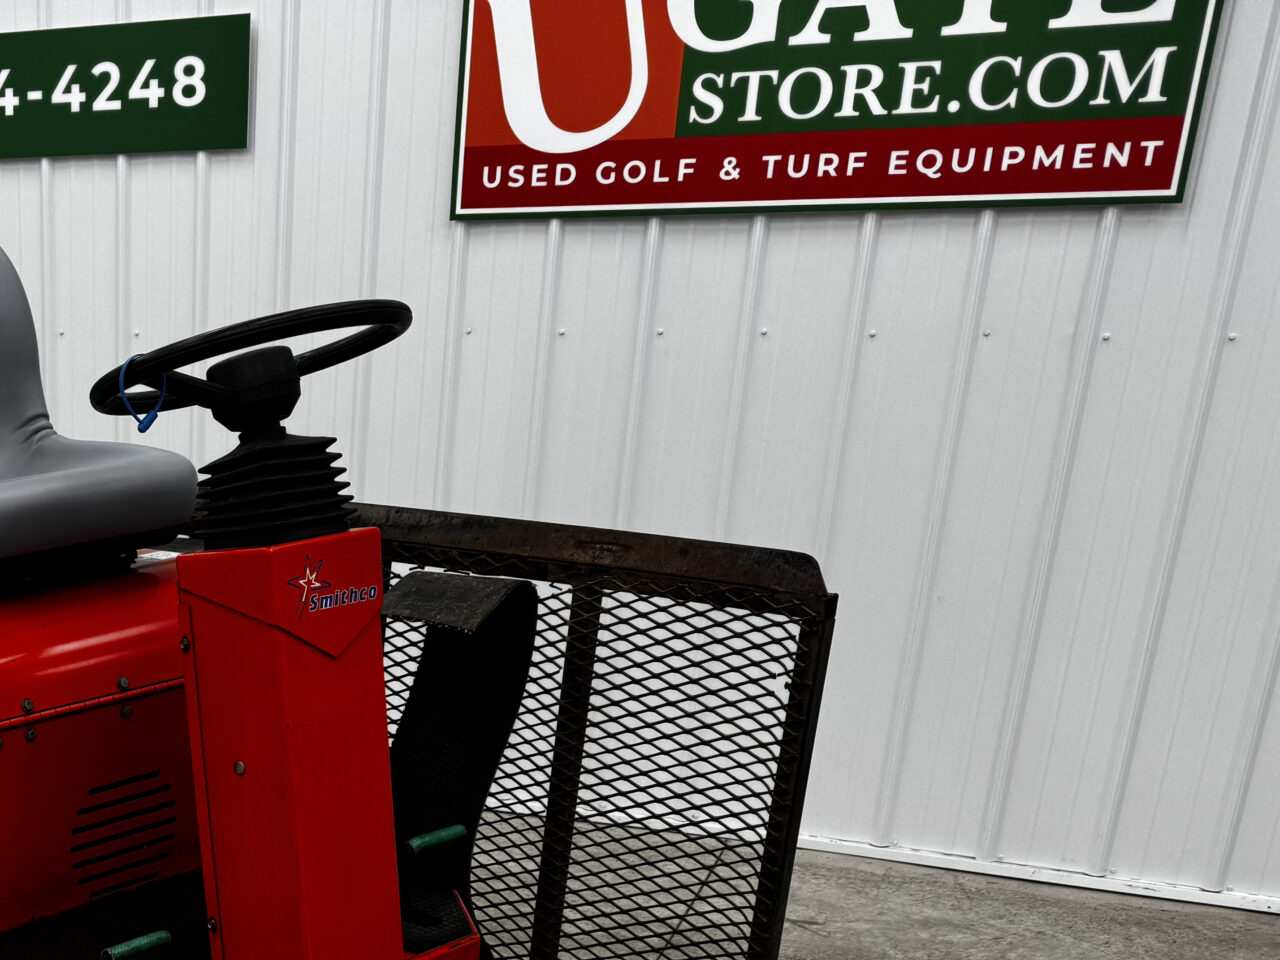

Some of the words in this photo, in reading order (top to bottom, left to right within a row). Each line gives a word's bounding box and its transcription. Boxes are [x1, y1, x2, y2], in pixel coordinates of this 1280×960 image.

[688, 45, 1178, 124] STORE.COM
[482, 163, 577, 189] USED
[595, 158, 697, 185] GOLF
[719, 156, 741, 181] &
[761, 151, 868, 179] TURF
[887, 140, 1165, 179] EQUIPMENT
[308, 585, 377, 612] Smithco
